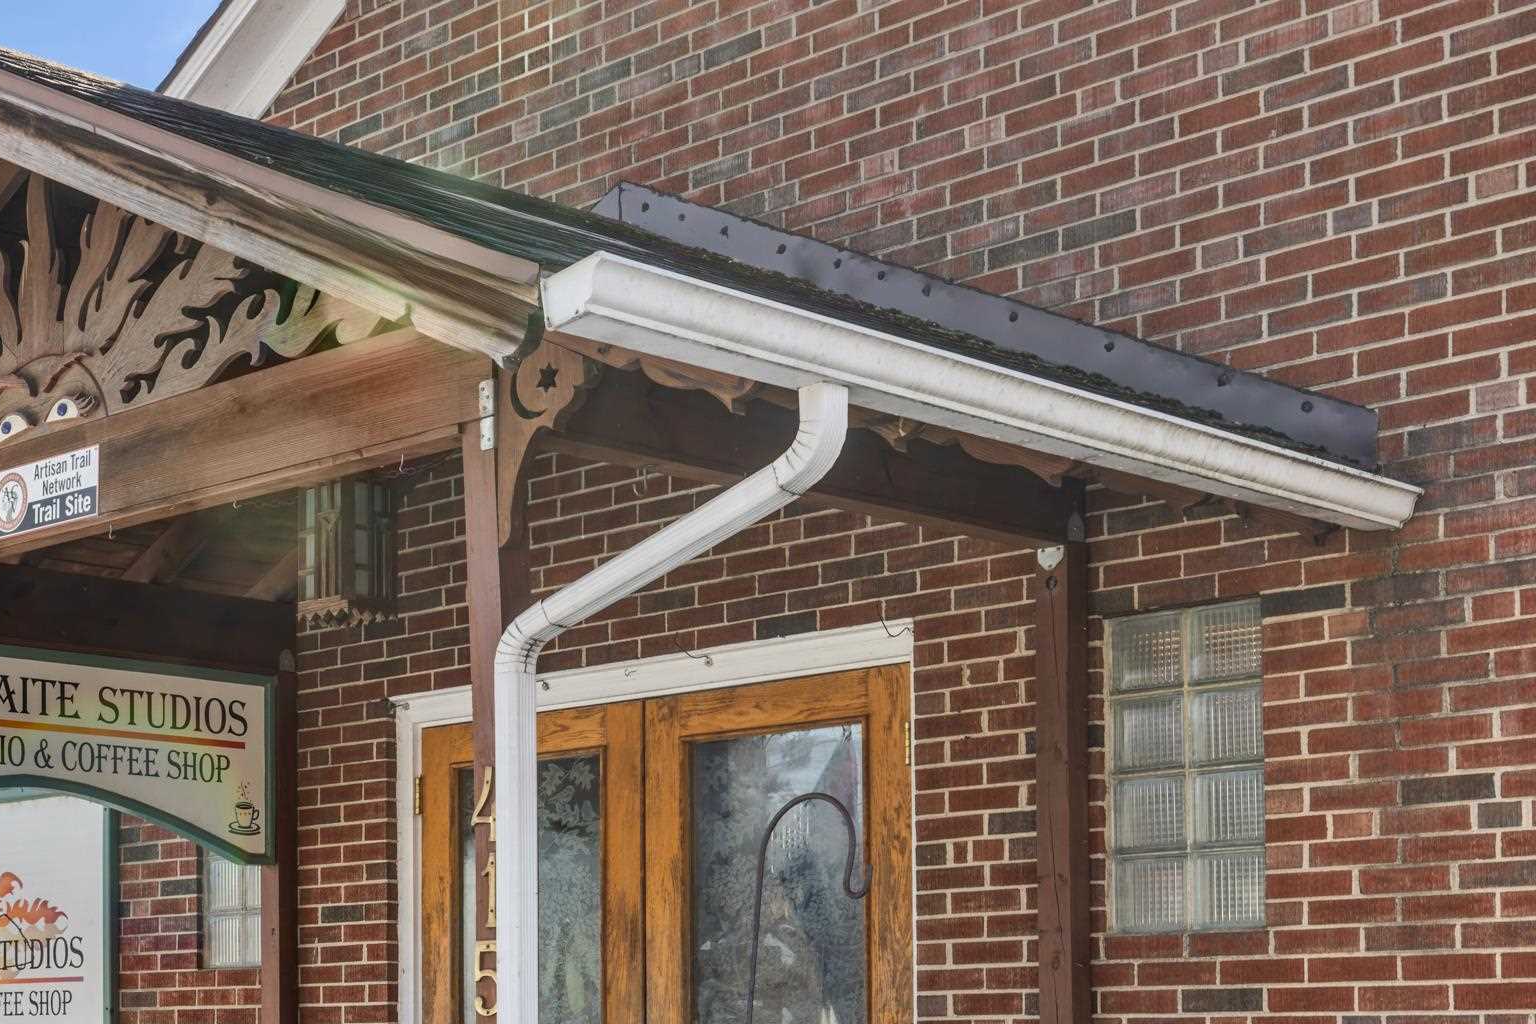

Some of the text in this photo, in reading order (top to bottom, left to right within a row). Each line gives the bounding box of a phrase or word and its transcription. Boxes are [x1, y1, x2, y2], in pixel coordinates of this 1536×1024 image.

[34, 450, 91, 480] Artisan Trail
[42, 473, 81, 496] Network
[32, 494, 91, 524] Trail Site
[98, 686, 248, 736] STUDIOS
[34, 738, 54, 769] &
[62, 740, 160, 778] COFFEE
[167, 750, 231, 783] SHOP
[29, 990, 72, 1016] SHOP
